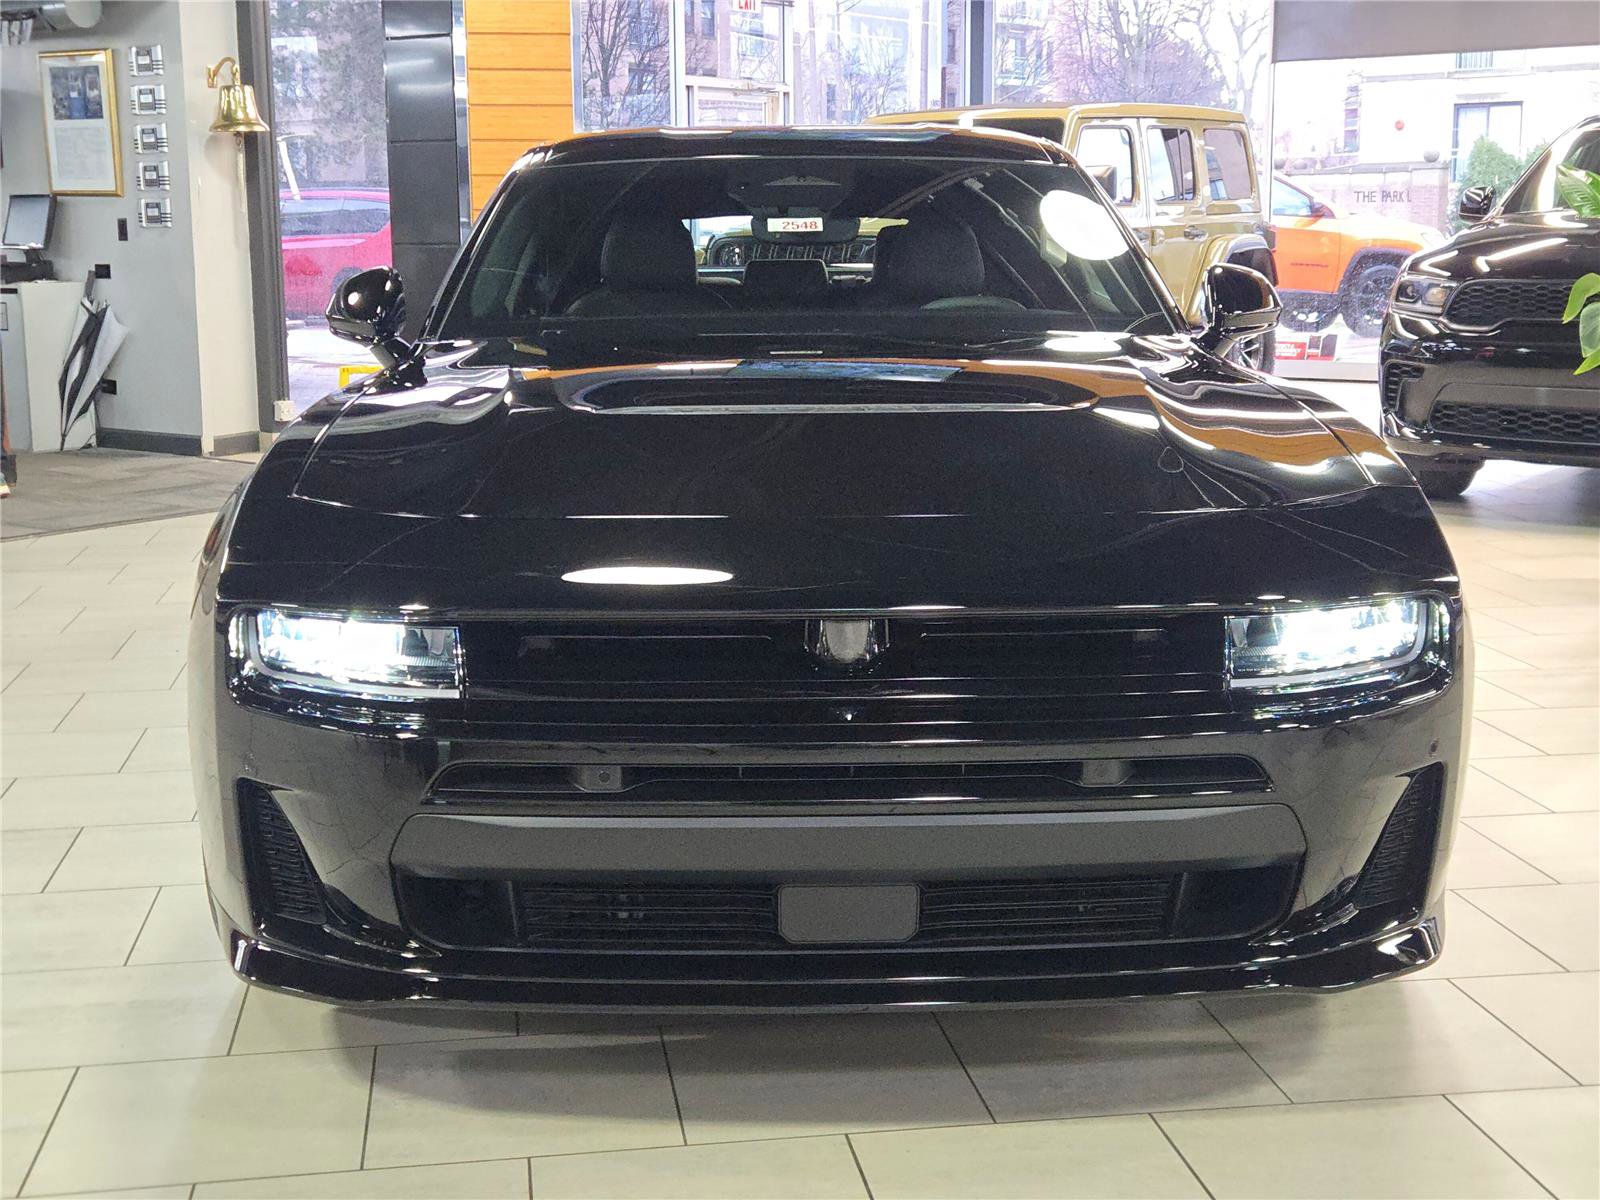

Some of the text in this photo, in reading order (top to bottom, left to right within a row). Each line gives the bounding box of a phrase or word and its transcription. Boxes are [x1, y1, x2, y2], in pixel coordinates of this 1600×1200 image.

[1353, 190, 1377, 203] THE
[1381, 190, 1404, 203] PARK
[782, 221, 818, 230] 2548
